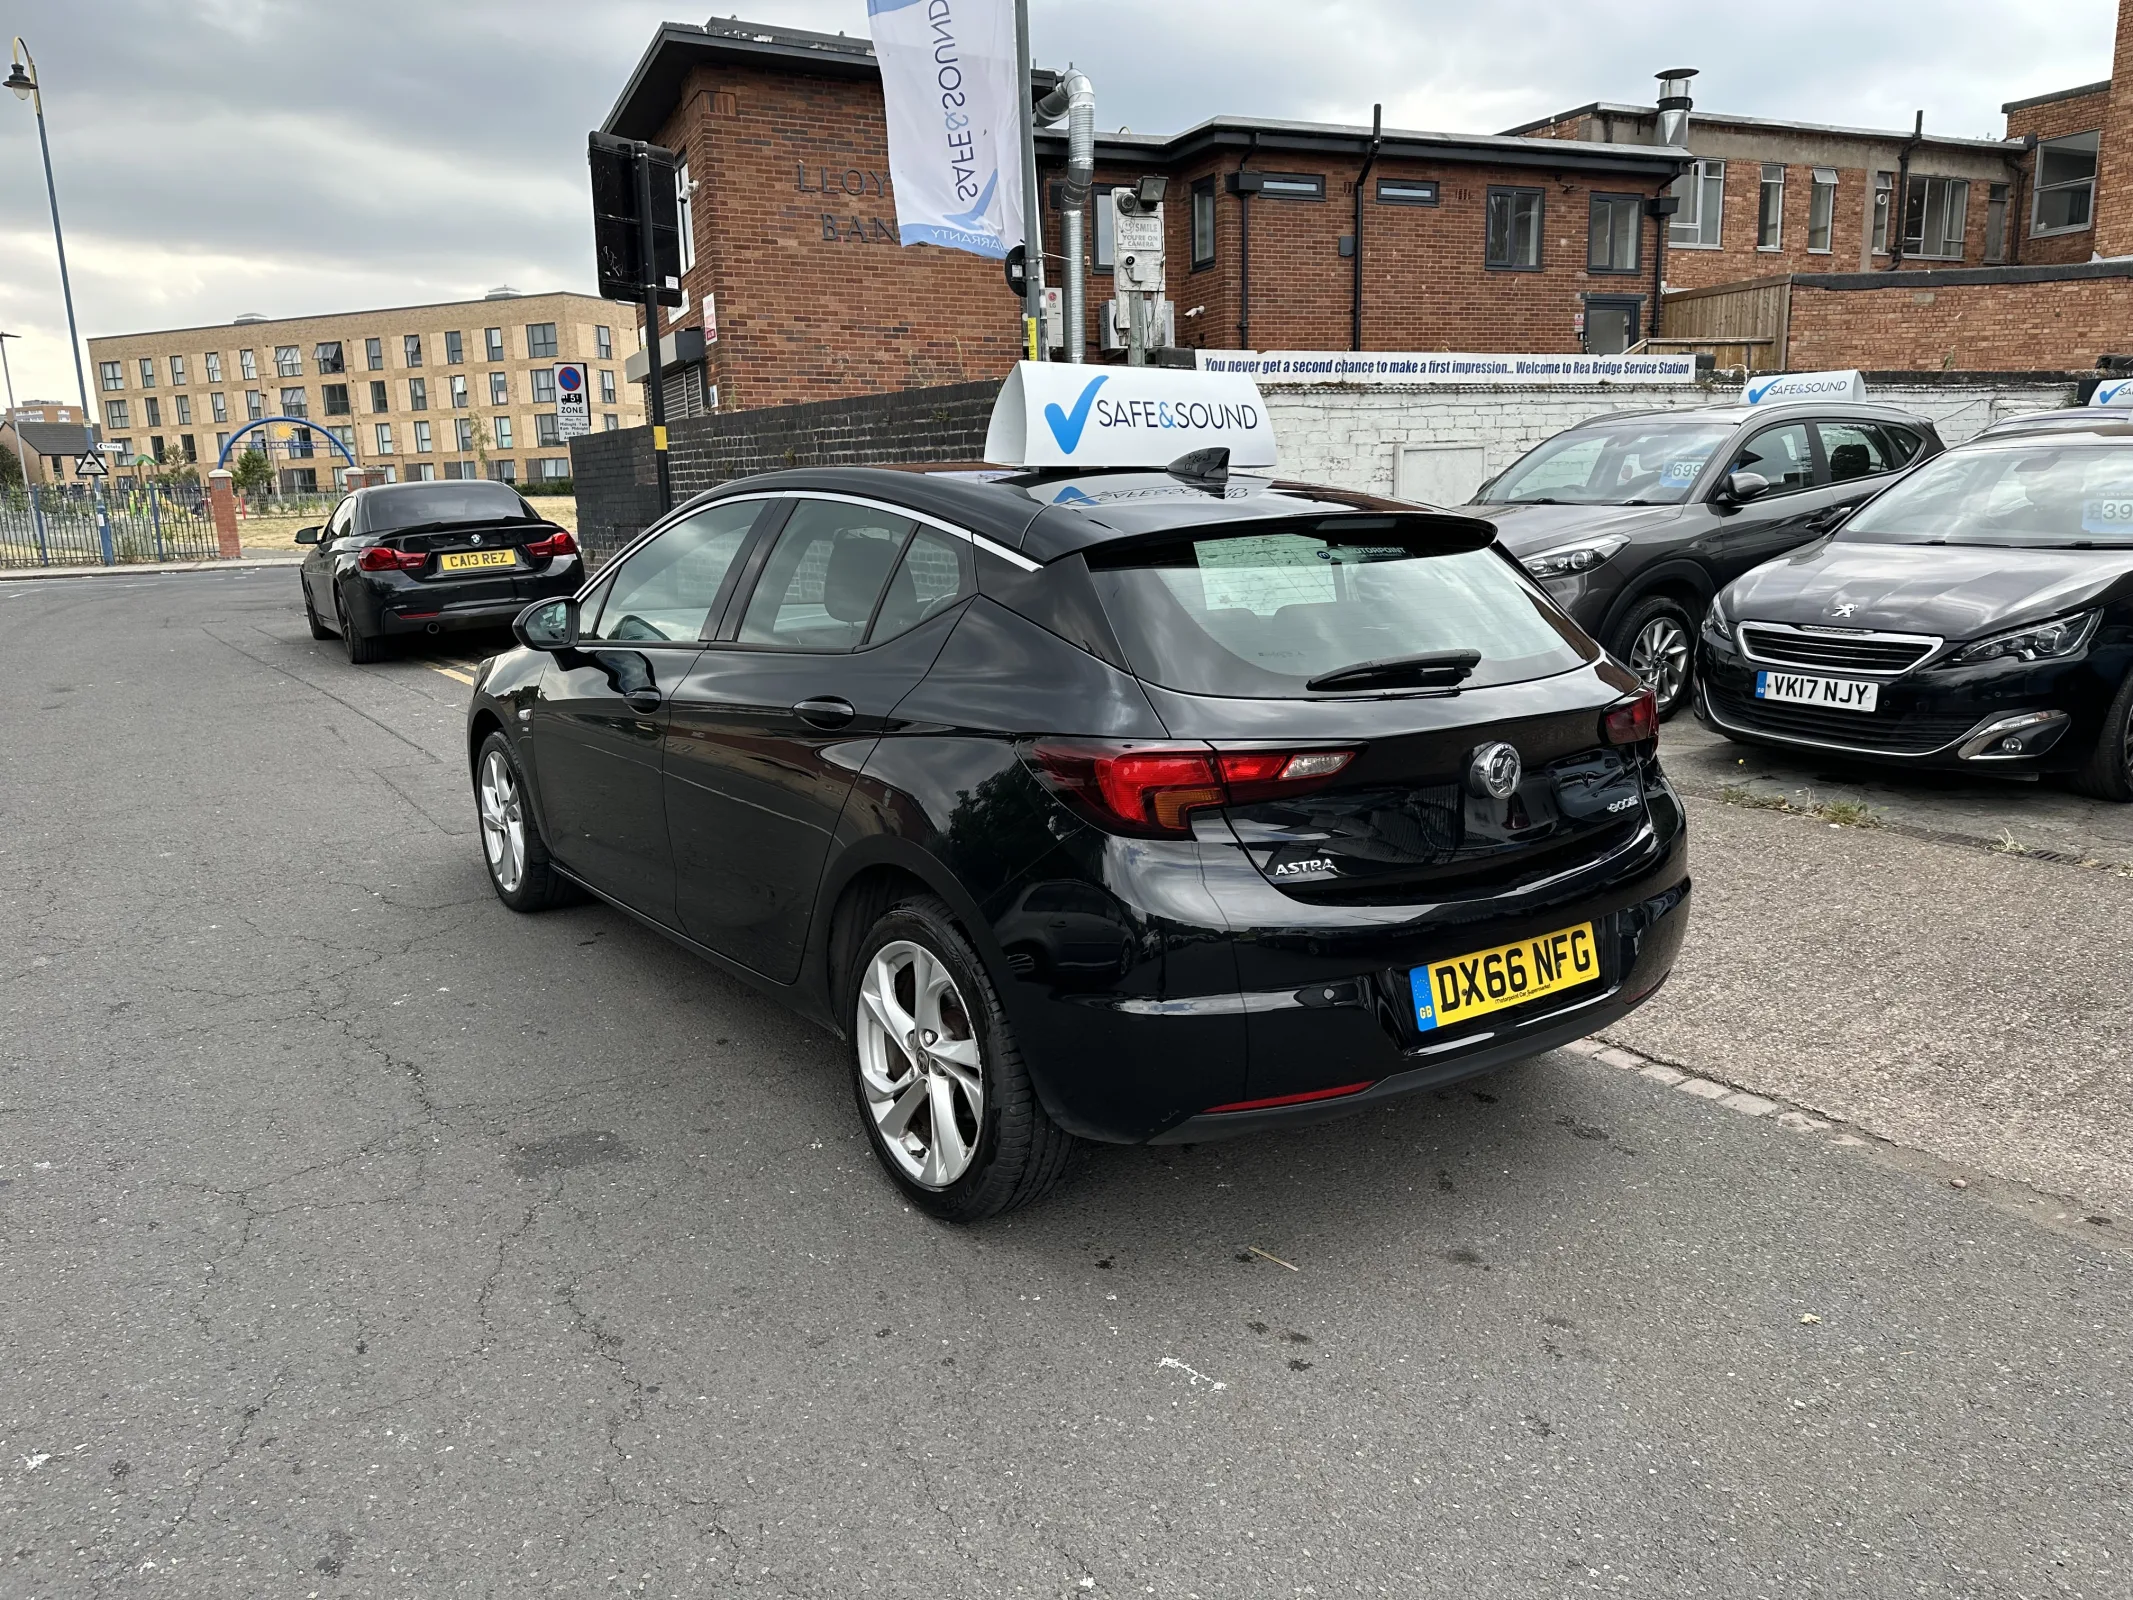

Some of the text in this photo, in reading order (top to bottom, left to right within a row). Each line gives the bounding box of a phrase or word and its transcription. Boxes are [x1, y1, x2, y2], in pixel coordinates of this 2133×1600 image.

[821, 213, 899, 243] BAN
[1135, 223, 1157, 232] SMILE
[1205, 358, 1690, 375] You never get a second chance to make a first impression... Welcome to Rea Bridge Service Station
[1769, 381, 1847, 395] SAFE&SOUND
[1097, 399, 1258, 430] SAFE&SOUND
[450, 552, 507, 567] CA13 REZ
[1774, 675, 1869, 705] VK17 NJY
[1275, 858, 1336, 875] ASTRA
[1435, 929, 1591, 1013] DX66 NFG
[1419, 1005, 1432, 1019] GB
